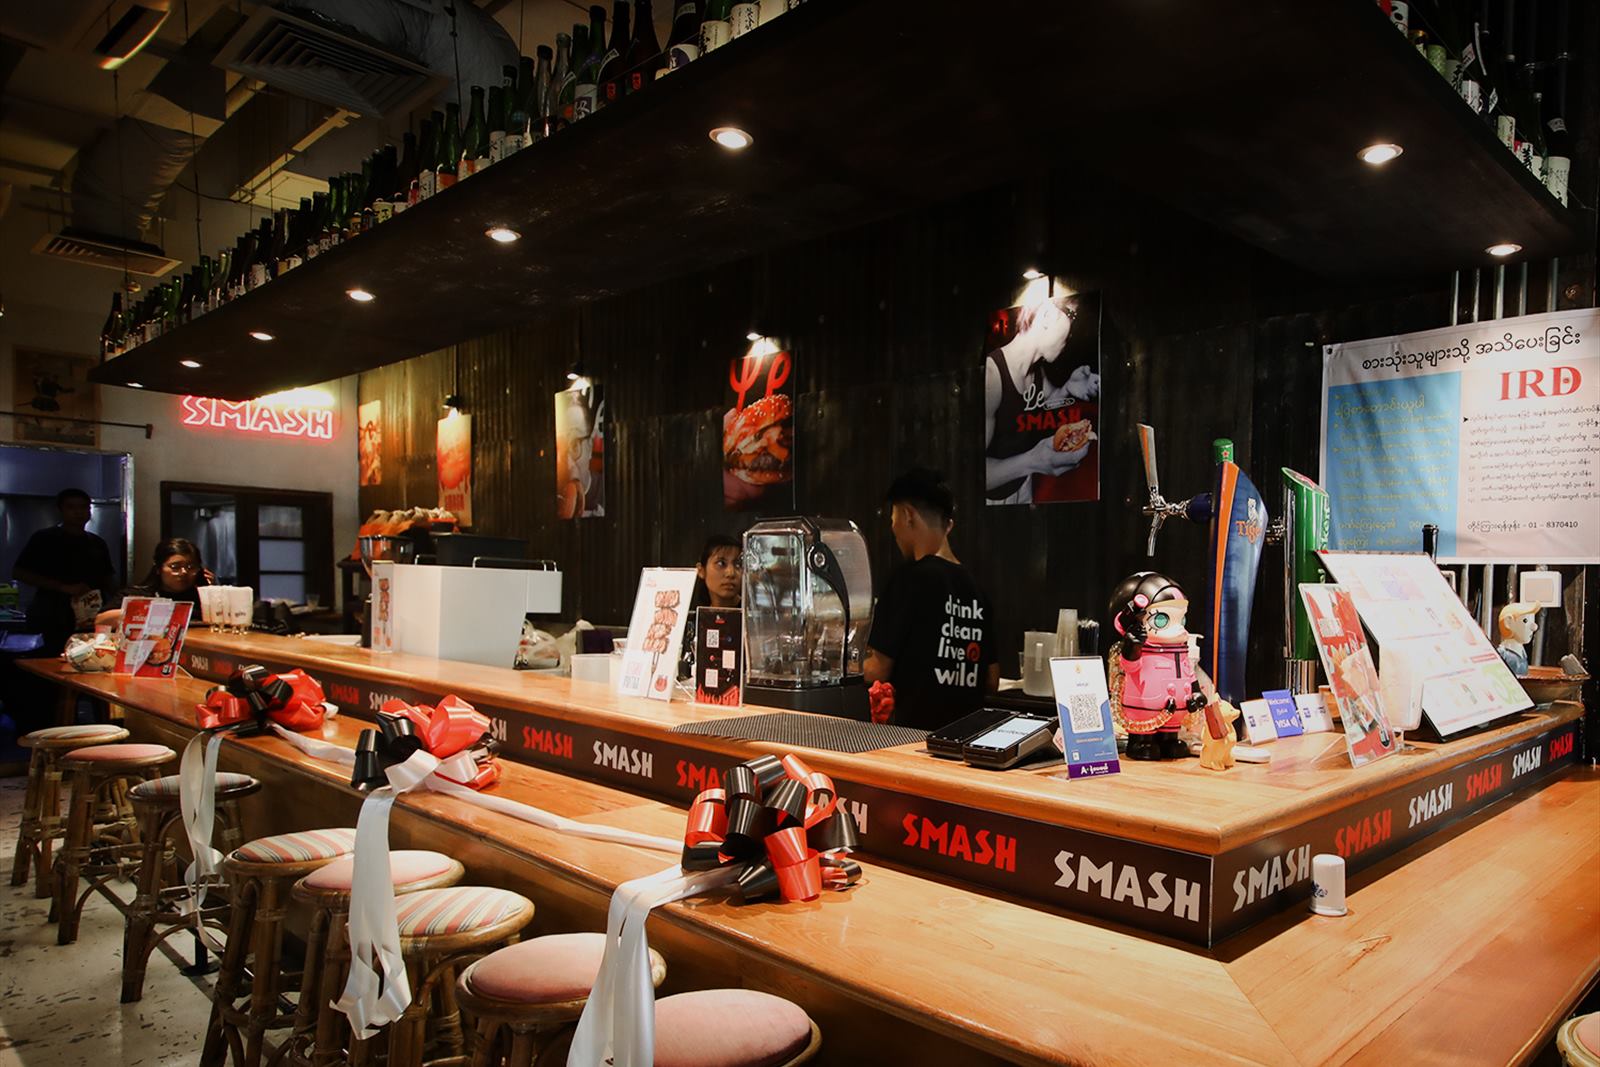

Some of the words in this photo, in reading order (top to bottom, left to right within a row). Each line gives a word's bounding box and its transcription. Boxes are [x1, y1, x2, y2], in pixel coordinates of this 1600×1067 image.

[1361, 337, 1472, 373] စားသုံးသူများသို့
[1475, 325, 1581, 355] အသိပေးခြင်း
[1500, 366, 1583, 401] IRD
[182, 395, 333, 439] SMASH
[1528, 521, 1537, 529] 01
[1546, 520, 1579, 529] 8370410
[945, 594, 984, 620] drink
[941, 616, 983, 642] clean
[937, 636, 966, 661] live
[934, 662, 979, 687] wild
[330, 683, 360, 705] SMASH
[522, 725, 573, 760] SMASH
[593, 740, 653, 778] SMASH
[1549, 733, 1574, 763] SMASH
[1512, 745, 1542, 780] SMASH
[1466, 763, 1502, 802] SMASH
[1408, 782, 1454, 829] SMASH
[902, 812, 1018, 873] SMASH
[1335, 808, 1392, 858] SMASH
[1053, 850, 1201, 923] SMASH
[1233, 843, 1311, 912] SMASH
